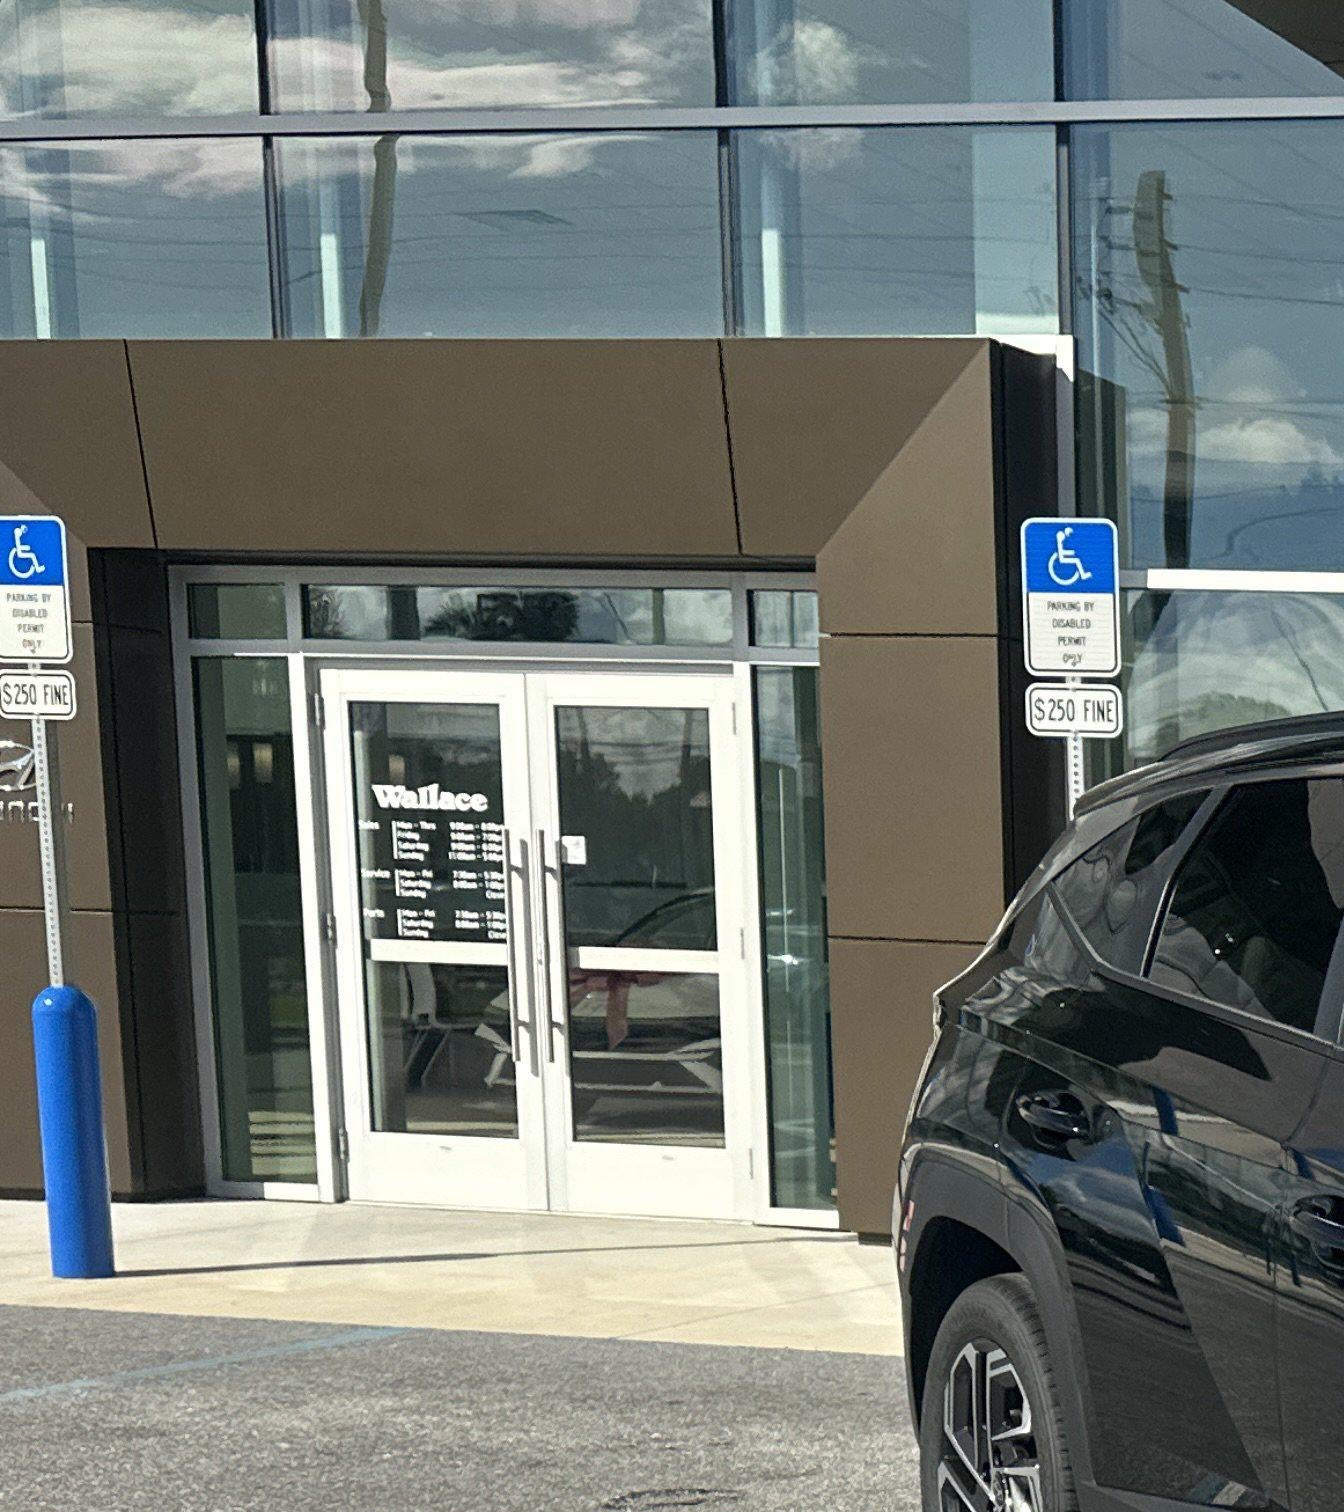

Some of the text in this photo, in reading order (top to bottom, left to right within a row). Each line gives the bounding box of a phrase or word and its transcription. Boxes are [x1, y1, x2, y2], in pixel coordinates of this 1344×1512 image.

[1047, 601, 1094, 612] PARKING BY
[1052, 618, 1091, 629] DISABLED
[1058, 636, 1086, 646] PERMIT
[2, 683, 69, 706] $250 FINE
[1034, 697, 1113, 723] $250 FINE
[372, 783, 488, 812] Wallace
